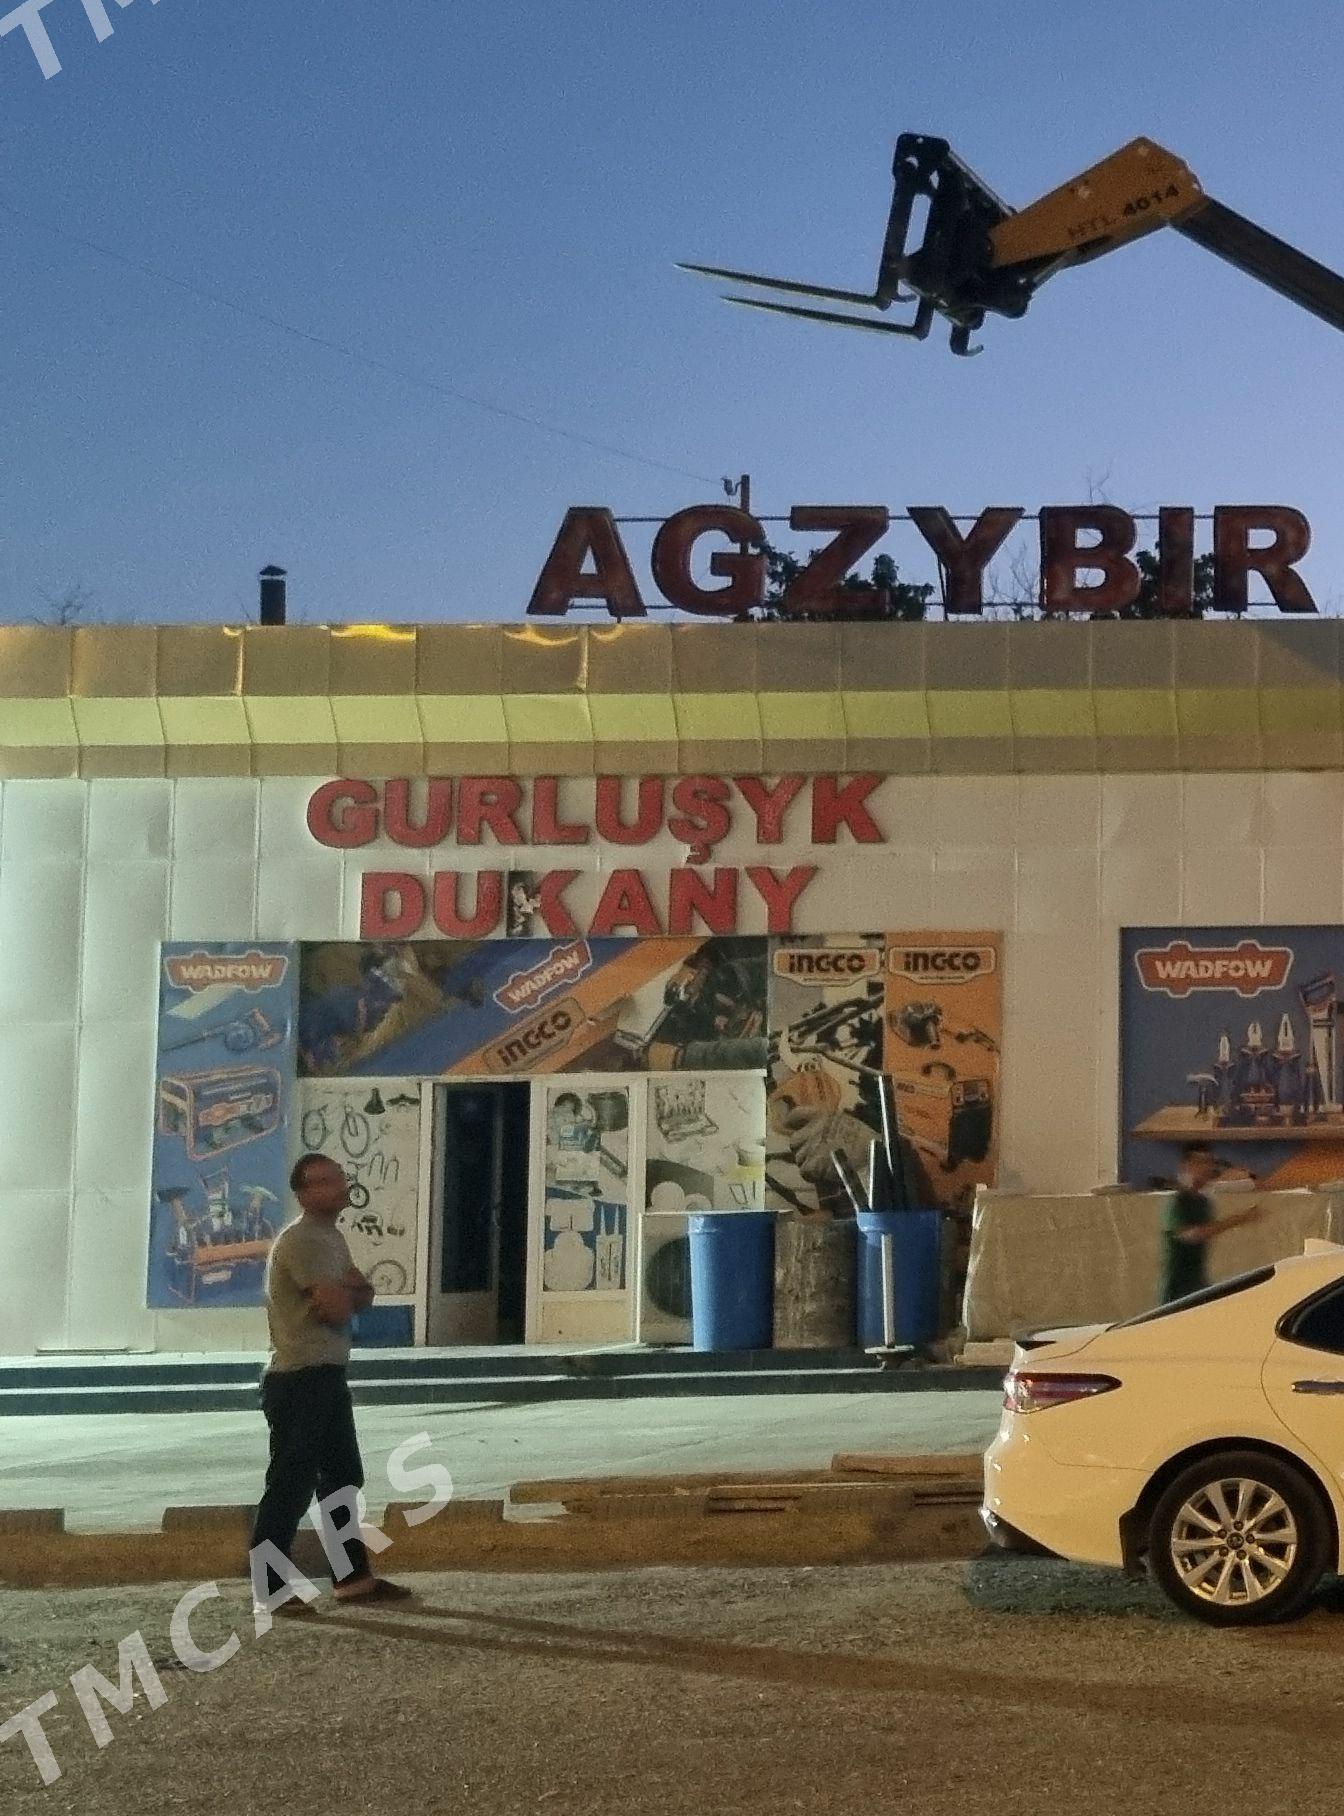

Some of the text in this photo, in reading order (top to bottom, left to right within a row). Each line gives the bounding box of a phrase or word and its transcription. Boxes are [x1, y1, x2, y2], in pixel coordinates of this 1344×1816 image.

[1123, 183, 1180, 217] 4014
[526, 504, 1319, 618] AGZYBIR
[306, 773, 888, 865] GURLUŞYK
[360, 865, 819, 940] DUKANY
[180, 963, 273, 980] WADFOW
[507, 951, 581, 1003] WADFOW
[1154, 958, 1274, 980] WADFOW
